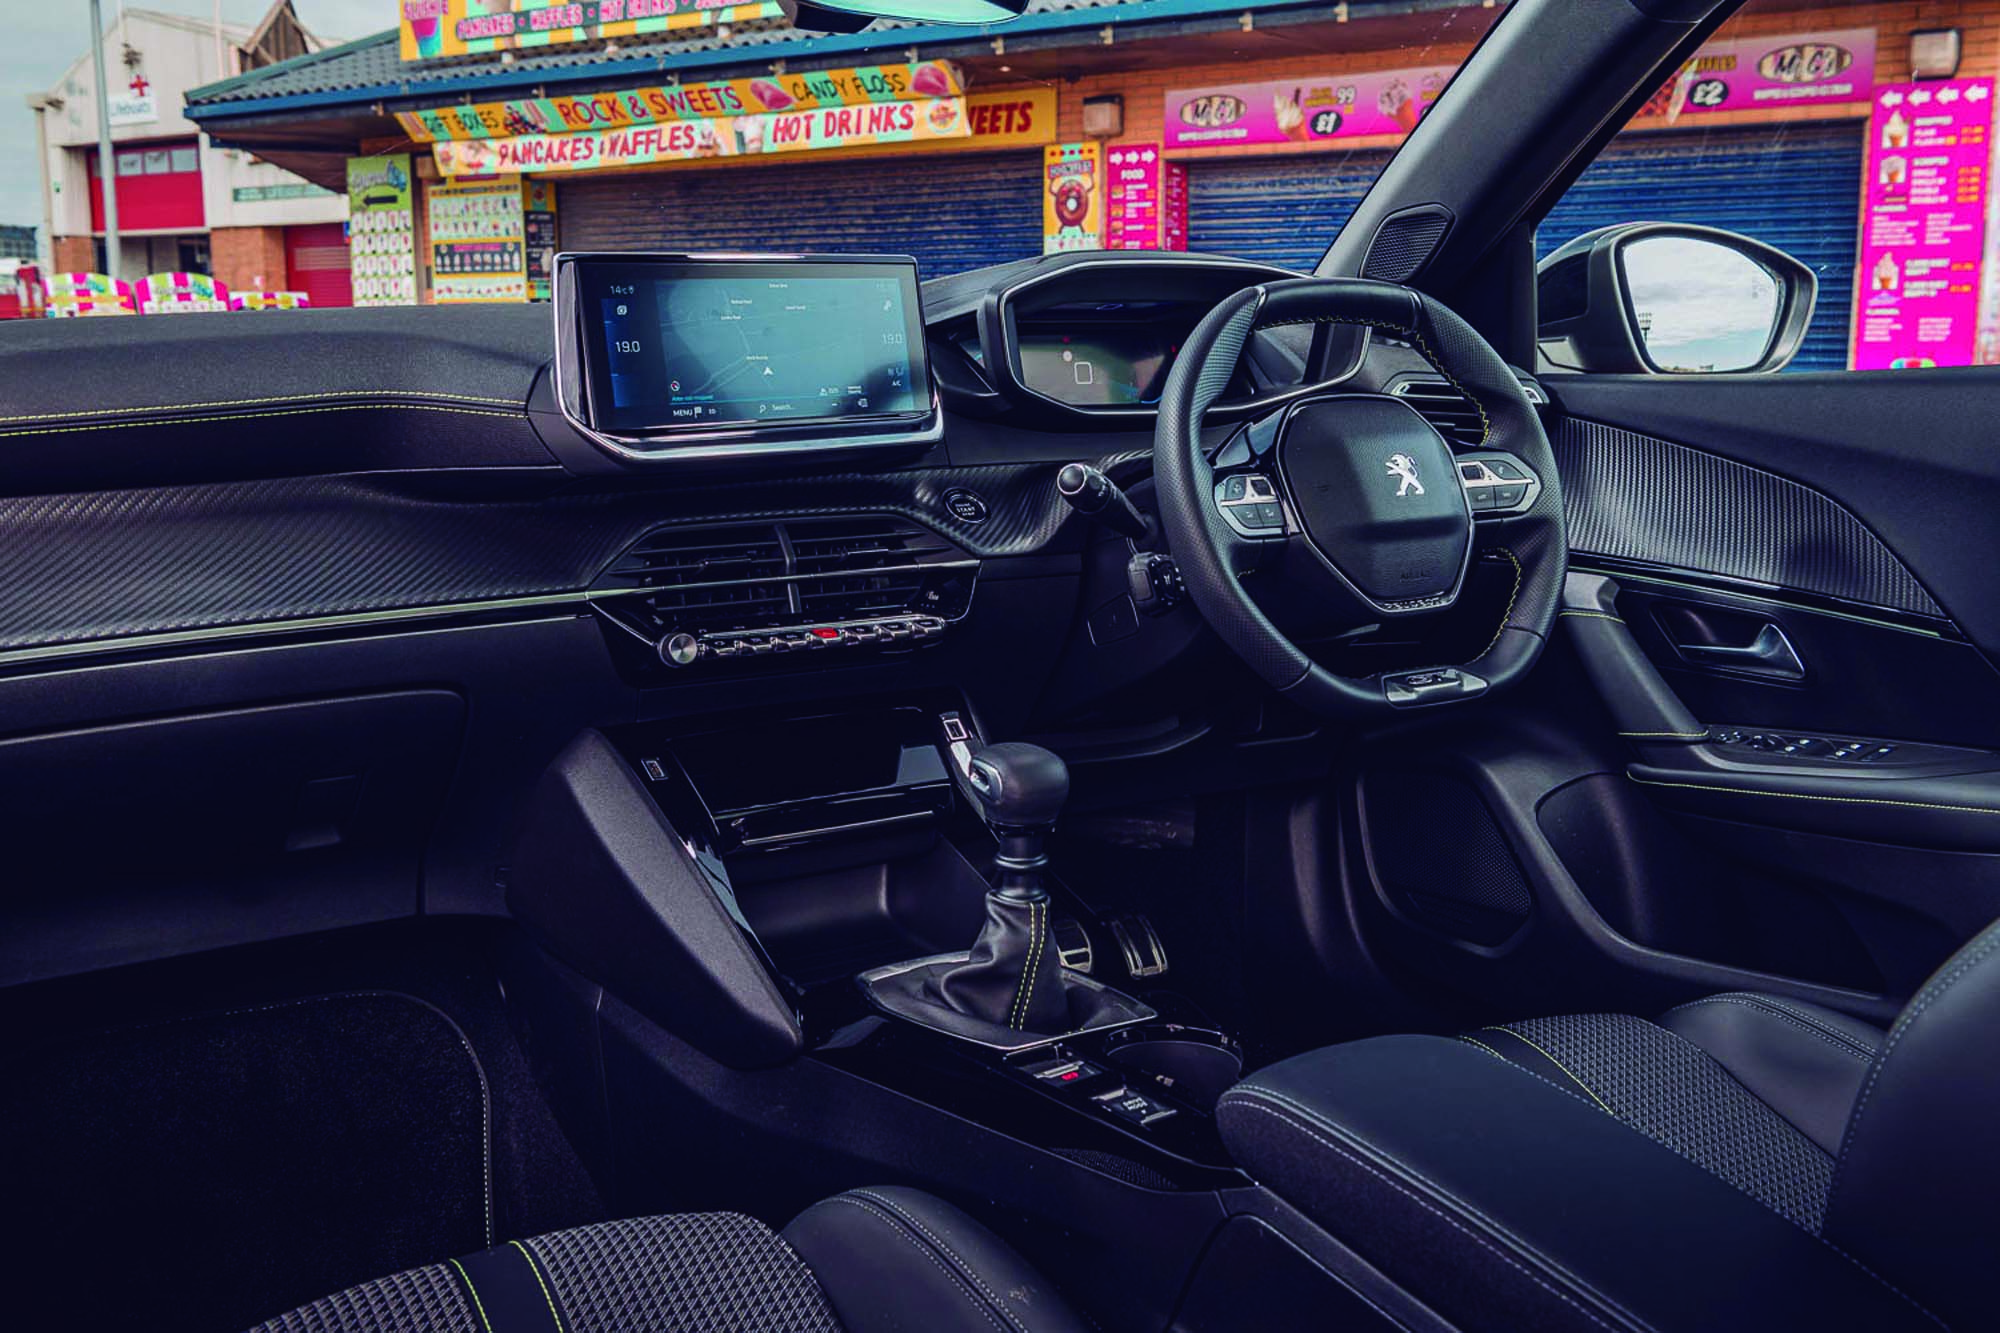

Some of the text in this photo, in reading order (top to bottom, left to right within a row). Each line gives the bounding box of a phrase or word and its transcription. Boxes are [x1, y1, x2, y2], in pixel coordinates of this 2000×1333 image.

[457, 12, 515, 40] PANCAKES
[530, 4, 583, 31] WAFFLES
[452, 109, 498, 131] BOXES
[557, 98, 627, 126] ROCK
[627, 95, 648, 118] &
[649, 86, 743, 116] SWEETS
[791, 78, 847, 101] CANDY
[851, 73, 906, 96] FLOSS
[1692, 80, 1724, 105] £2
[498, 137, 594, 166] PANCAKES
[607, 124, 695, 158] WAFFLES
[772, 113, 815, 143] HOT
[824, 103, 914, 138] DRINKS
[1315, 111, 1337, 133] £1
[616, 340, 641, 353] 19.0
[672, 409, 693, 417] MENU
